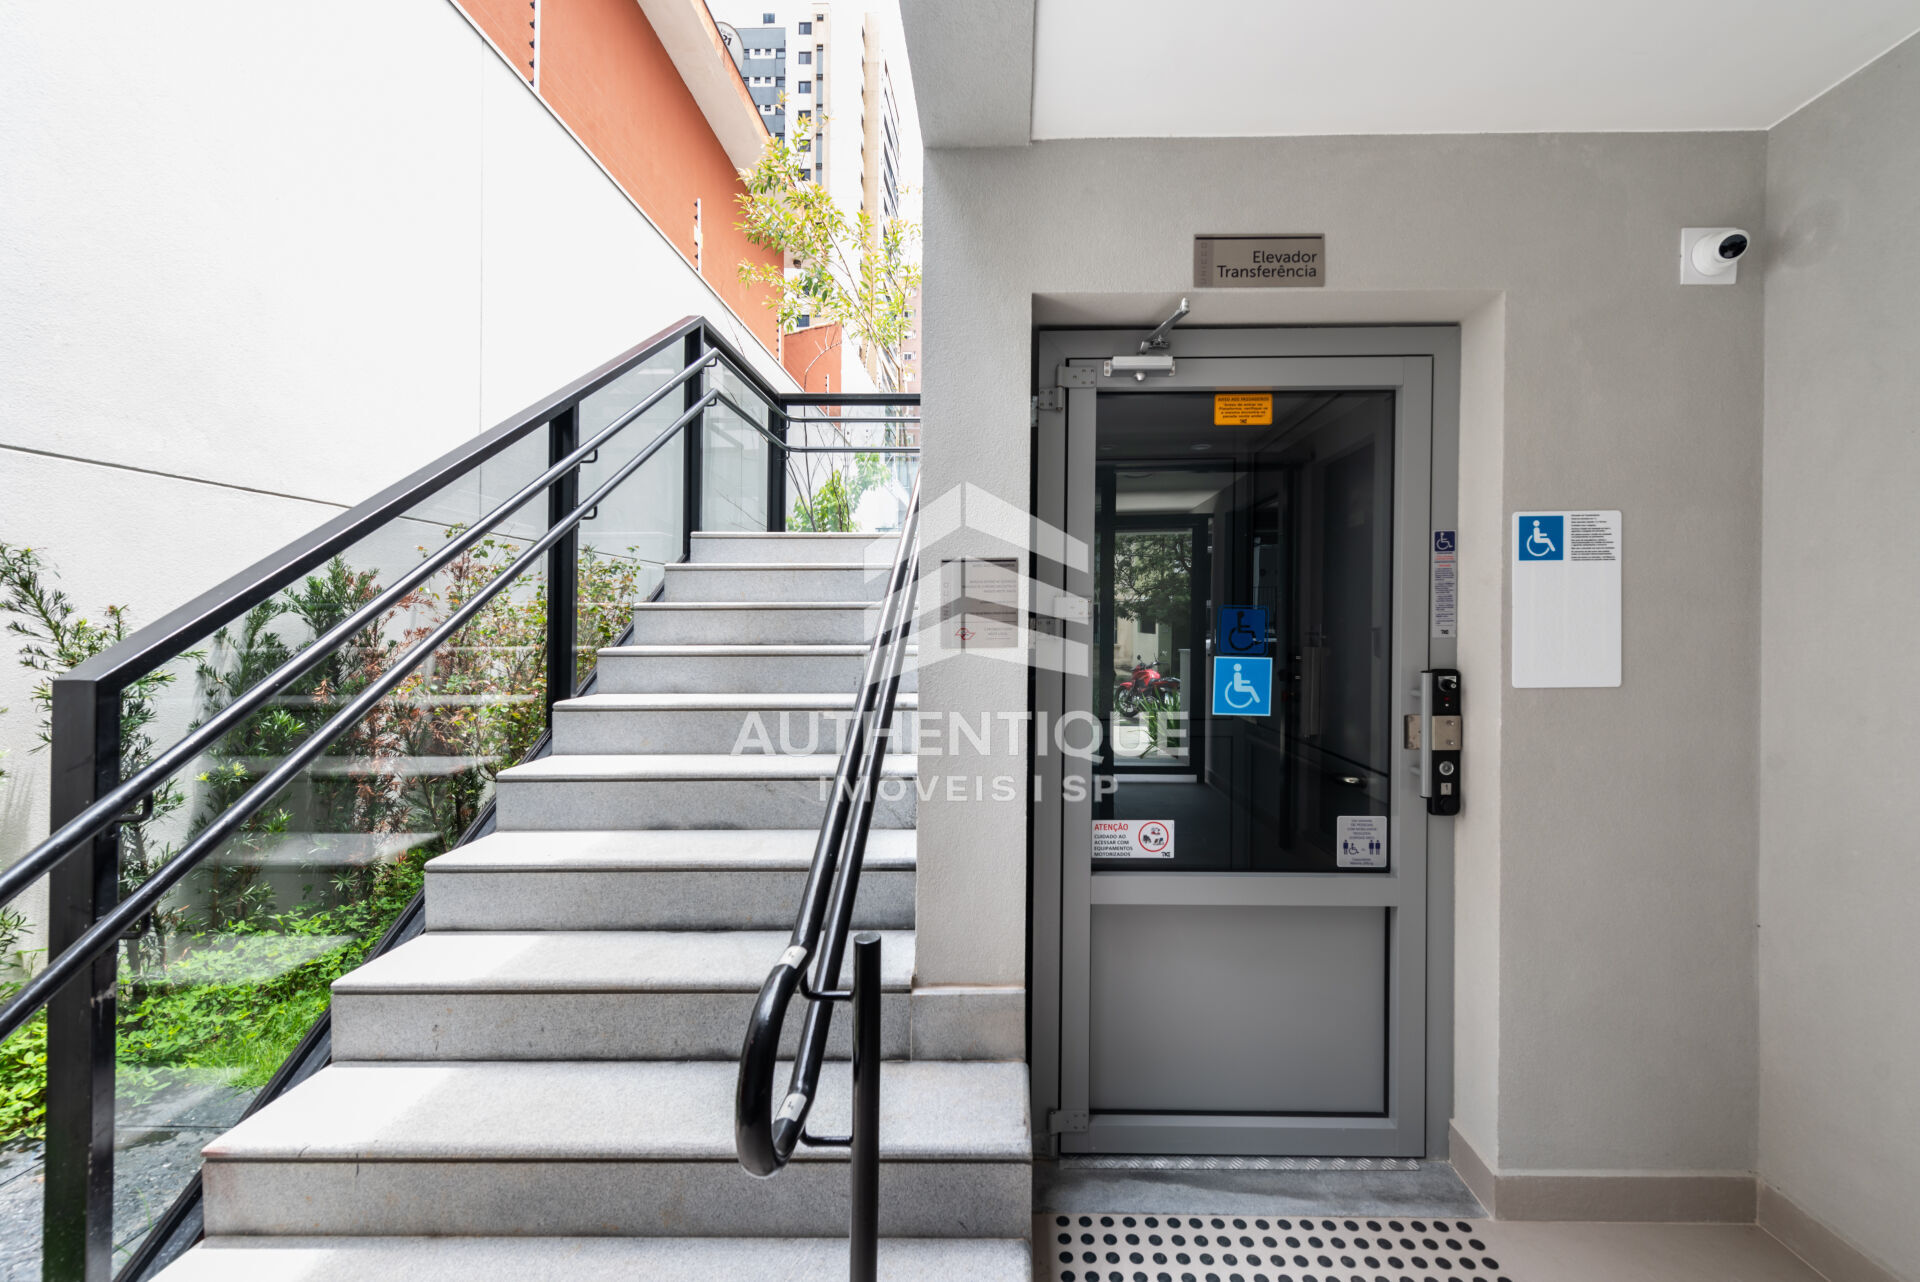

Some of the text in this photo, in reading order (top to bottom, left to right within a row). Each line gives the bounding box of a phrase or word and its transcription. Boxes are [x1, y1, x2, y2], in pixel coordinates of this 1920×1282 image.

[1253, 250, 1317, 263] Elevador
[1216, 265, 1317, 278] Transferência
[1095, 822, 1128, 832] ATENÇÃO
